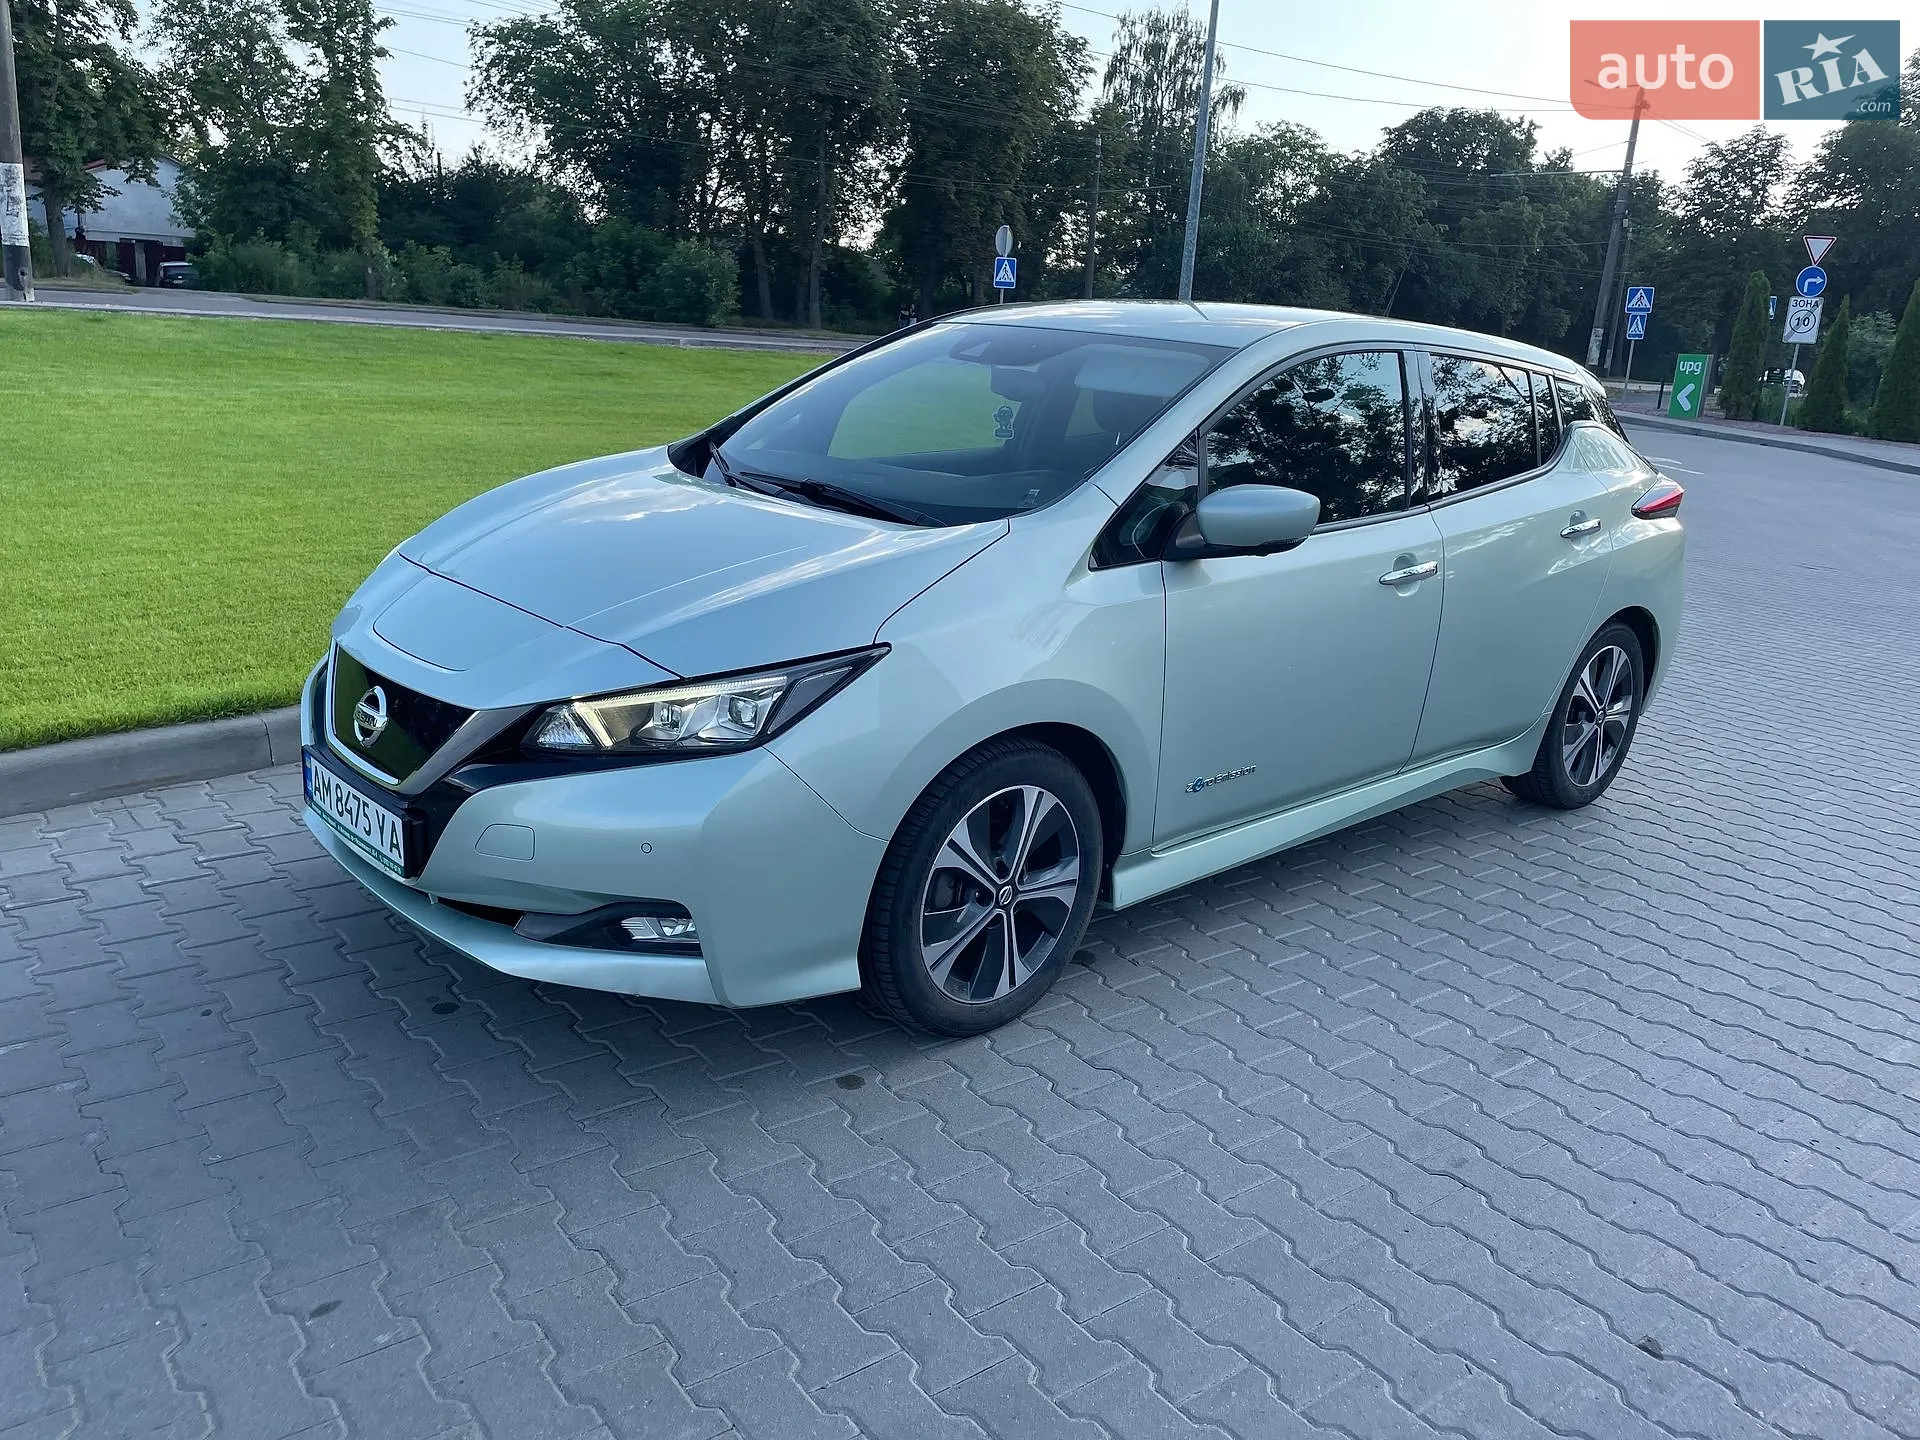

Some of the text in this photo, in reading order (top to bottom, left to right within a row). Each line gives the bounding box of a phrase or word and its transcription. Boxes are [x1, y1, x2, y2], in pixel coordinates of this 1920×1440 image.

[1792, 299, 1819, 308] ЗОНА
[1795, 316, 1810, 327] 10
[1680, 361, 1702, 375] upg
[314, 765, 333, 810] AM
[335, 783, 372, 837] 8475
[375, 808, 402, 860] YA
